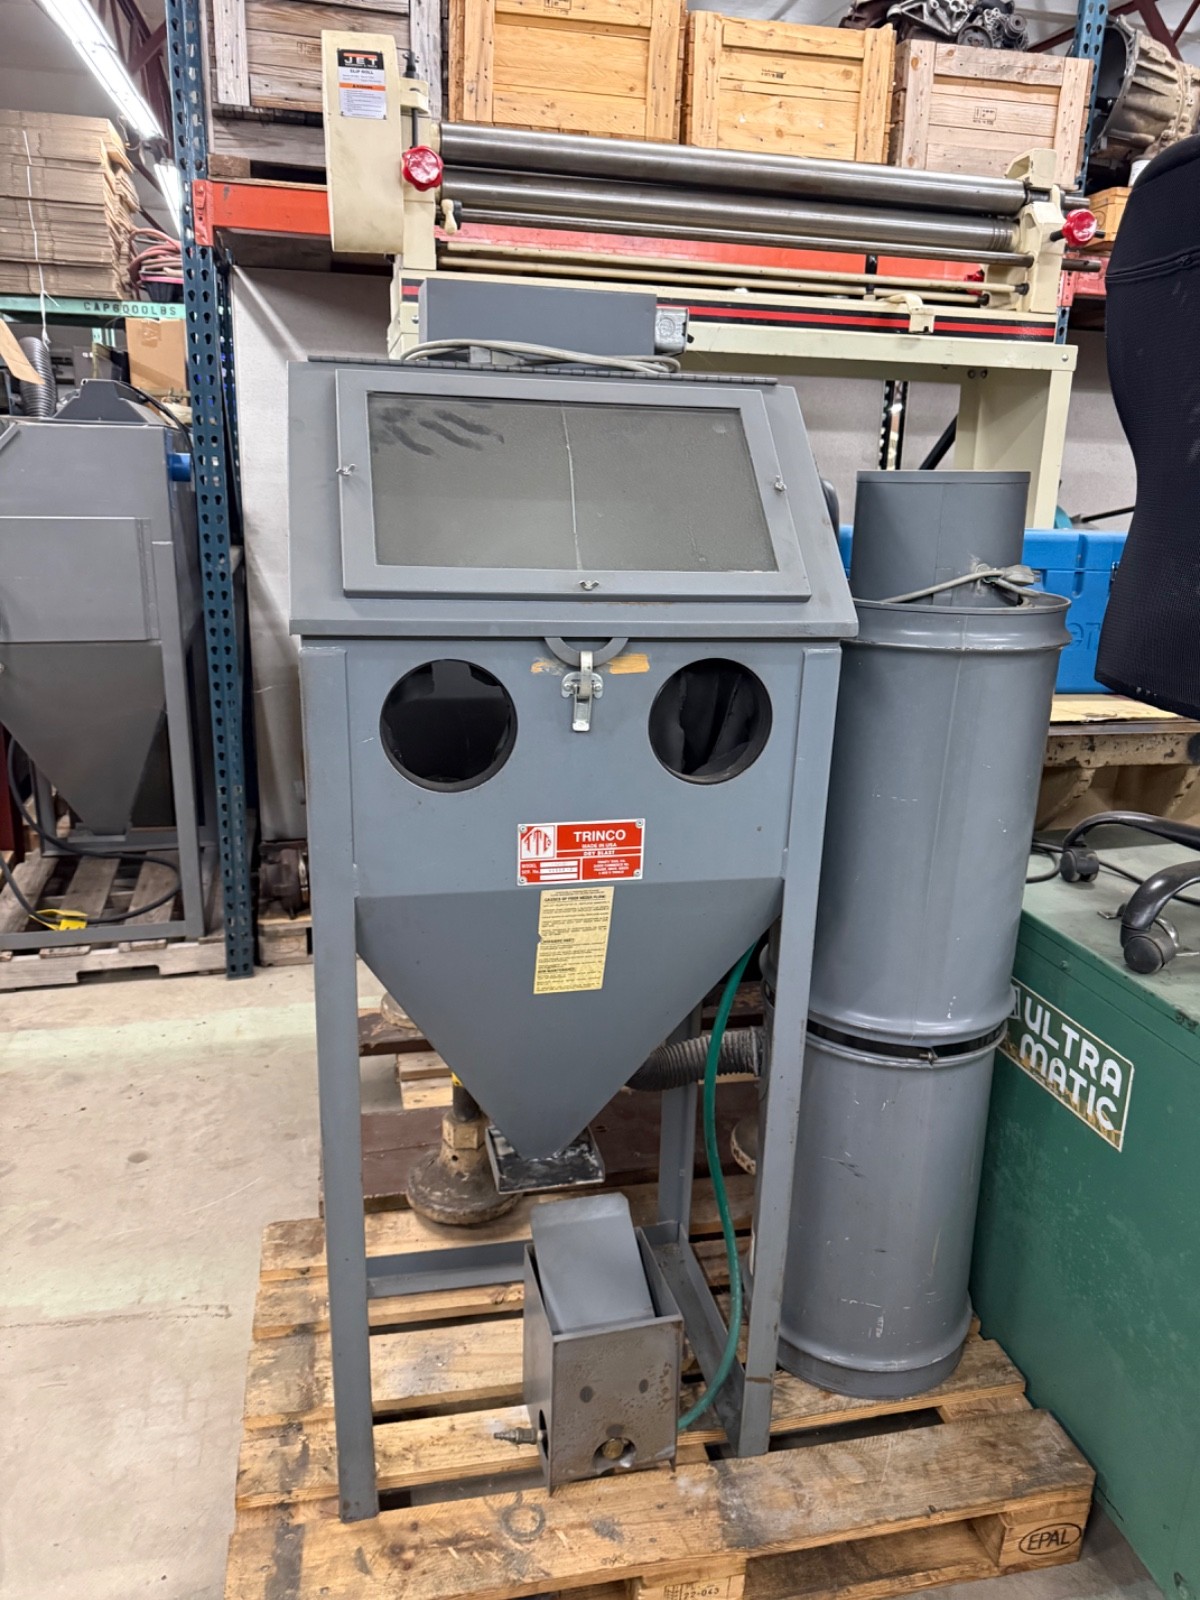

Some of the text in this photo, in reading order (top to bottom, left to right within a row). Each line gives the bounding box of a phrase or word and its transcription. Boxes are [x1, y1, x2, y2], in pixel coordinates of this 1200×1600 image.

[344, 56, 377, 66] JET
[573, 829, 626, 842] TRINCO
[1024, 996, 1123, 1098] ULTRA
[1019, 1033, 1118, 1131] MATIC
[1027, 1528, 1070, 1551] EPAL
